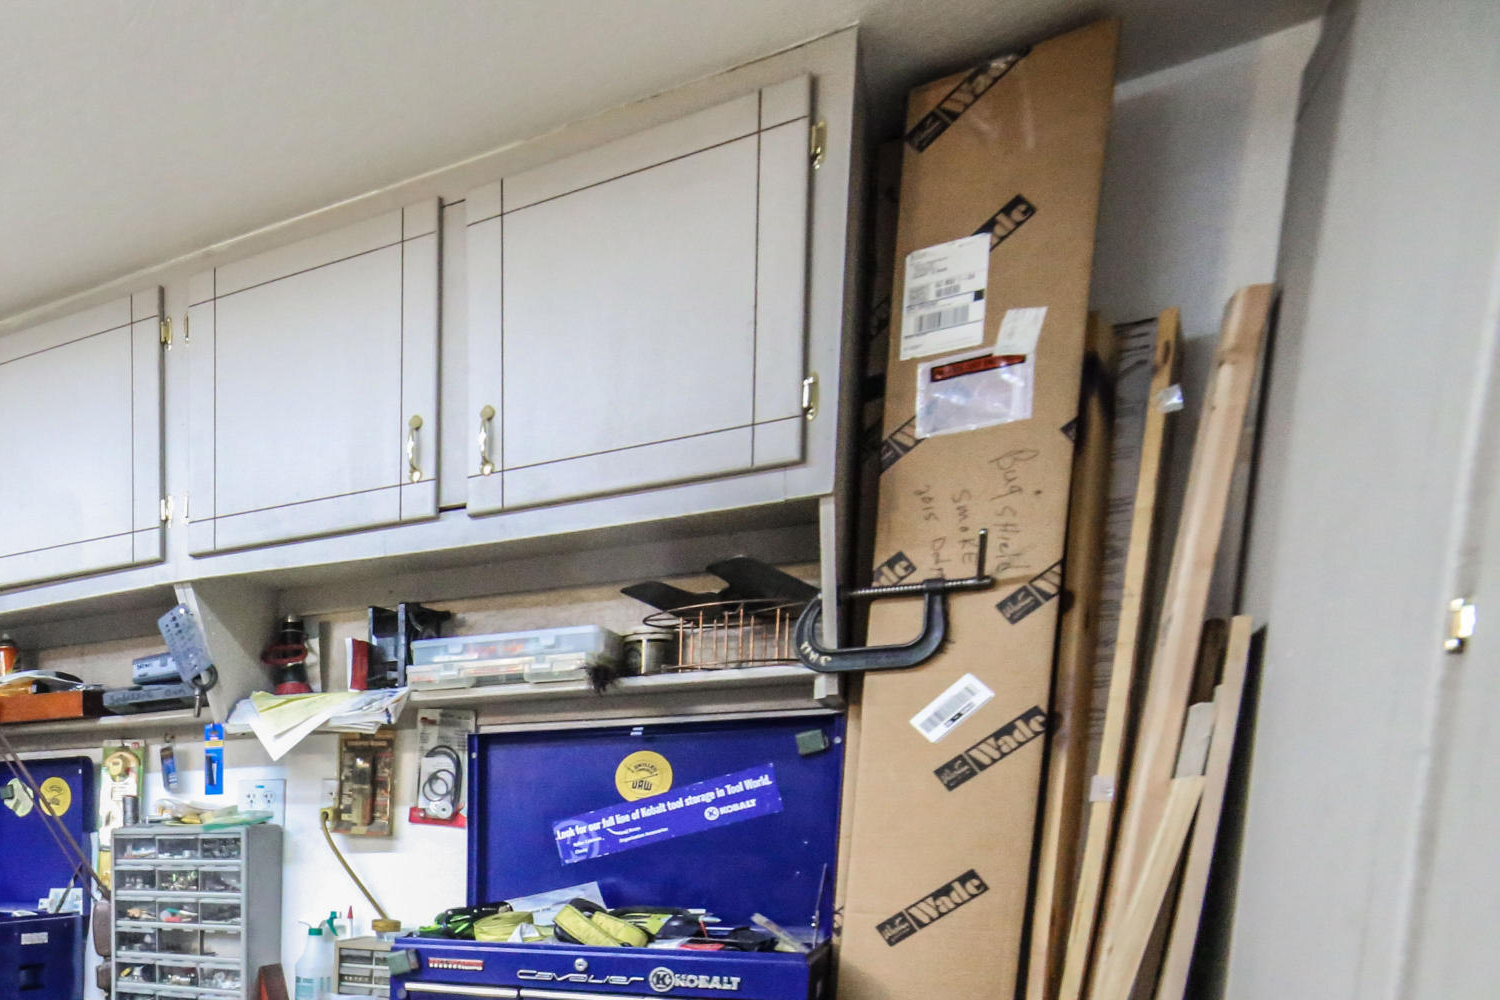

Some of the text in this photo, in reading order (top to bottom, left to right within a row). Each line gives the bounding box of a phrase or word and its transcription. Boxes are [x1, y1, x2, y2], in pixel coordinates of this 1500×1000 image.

[631, 780, 653, 791] UAW
[556, 825, 575, 840] Look
[575, 824, 587, 835] for
[588, 822, 601, 832] our
[602, 816, 616, 829] full
[616, 813, 630, 825] line
[631, 808, 640, 820] of
[640, 803, 667, 818] Kobalt
[667, 796, 684, 811] tool
[684, 790, 715, 807] storage
[716, 786, 725, 798] in
[726, 780, 743, 796] Tool
[719, 798, 757, 815] KOBALT
[907, 878, 986, 923] Wade
[674, 973, 741, 991] KOBALT
